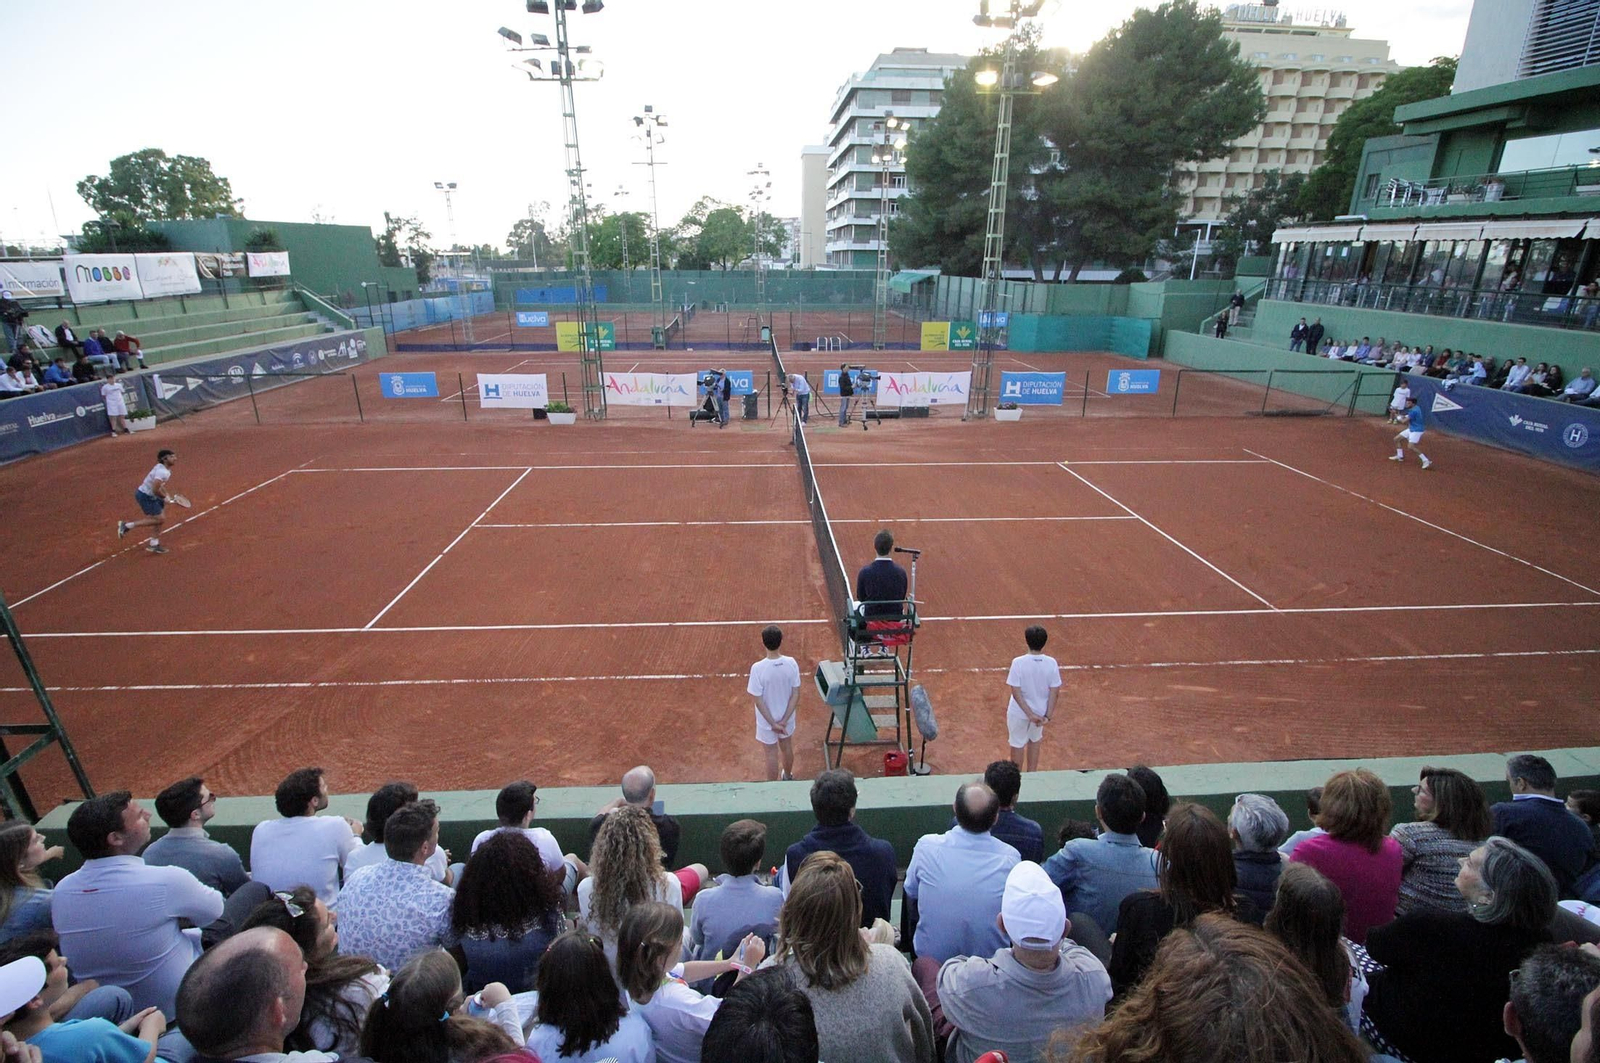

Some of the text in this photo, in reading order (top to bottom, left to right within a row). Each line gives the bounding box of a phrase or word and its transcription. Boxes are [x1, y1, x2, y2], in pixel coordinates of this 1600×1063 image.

[3, 277, 60, 289] Inormación
[501, 382, 544, 390] DIPUTACIÓN
[606, 375, 689, 396] Andalucía
[885, 375, 964, 396] Andalucía
[27, 411, 57, 426] Huelva
